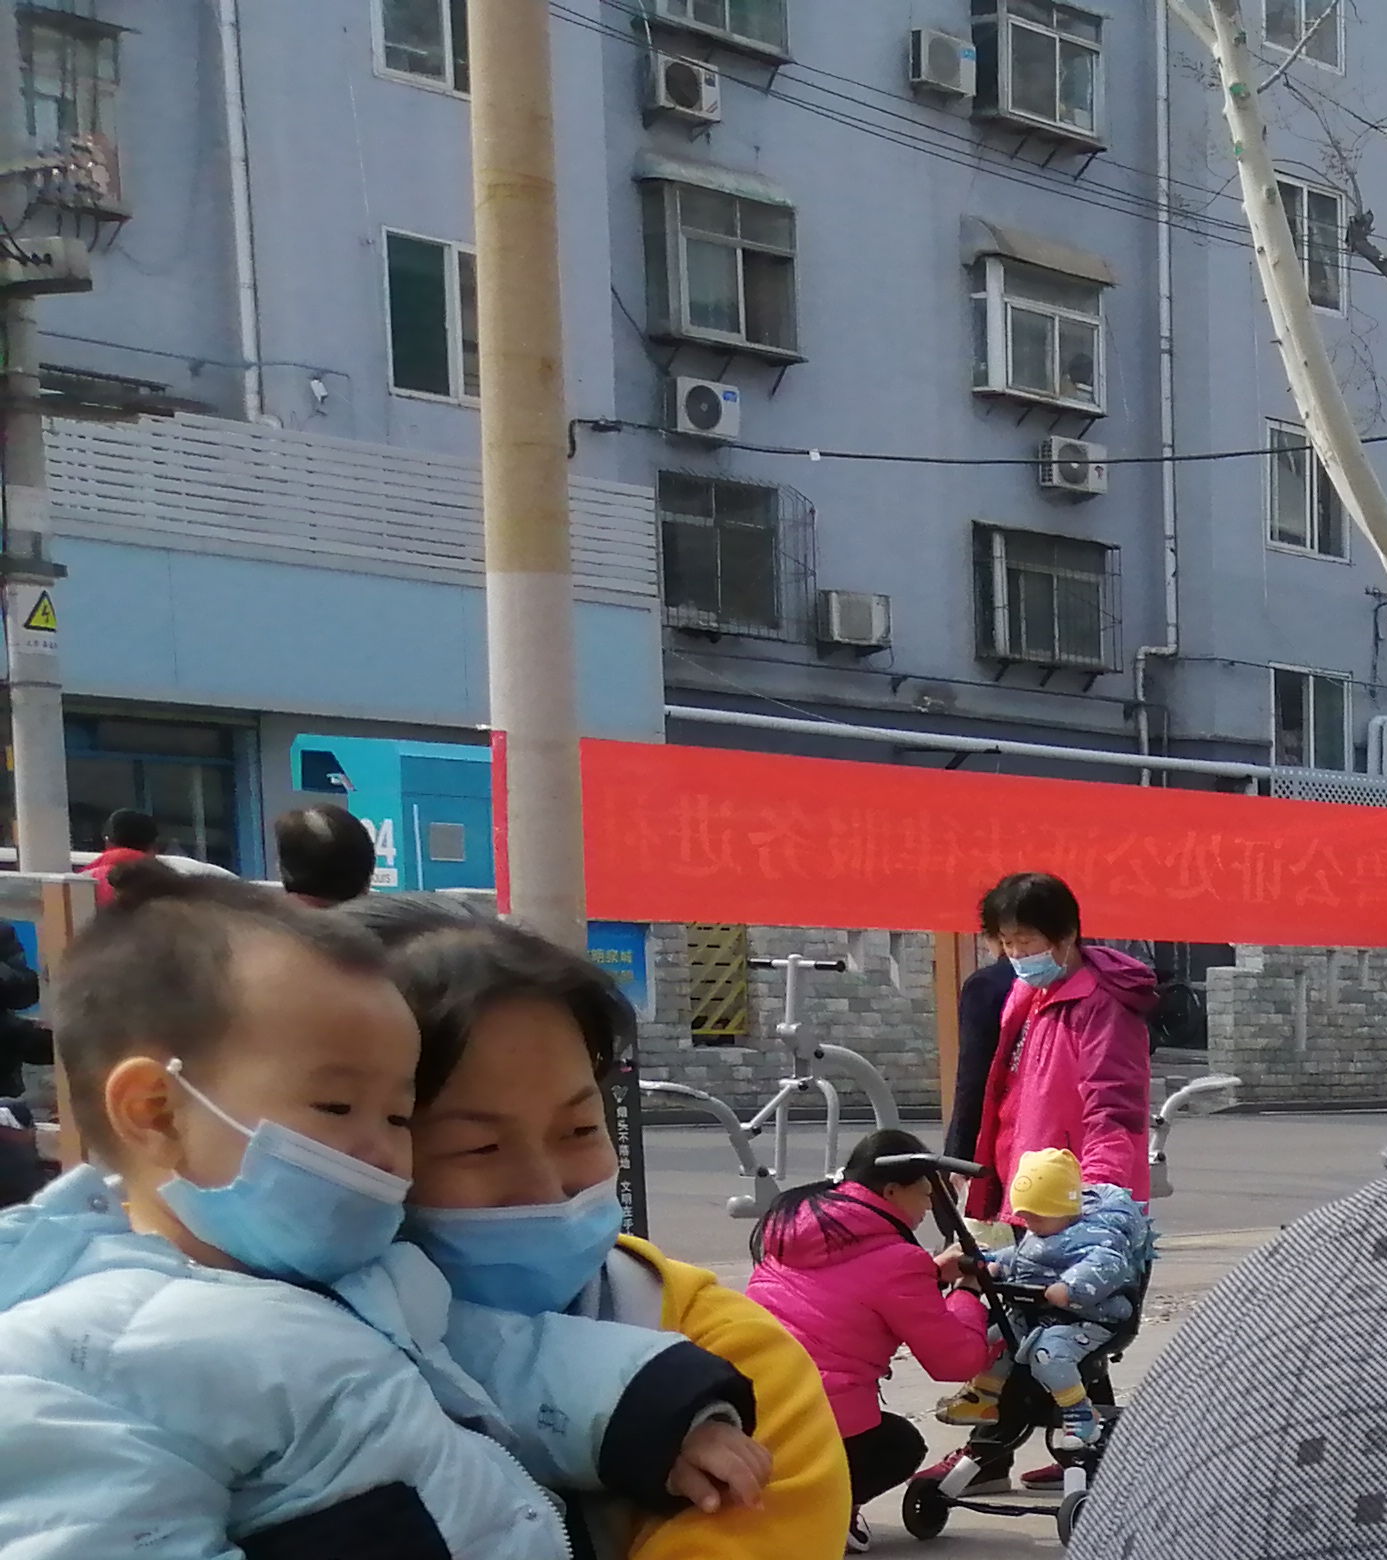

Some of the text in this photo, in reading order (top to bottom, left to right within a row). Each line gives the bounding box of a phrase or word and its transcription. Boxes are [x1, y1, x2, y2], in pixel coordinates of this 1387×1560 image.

[615, 1105, 634, 1236] 烟头不落地 文明在手
